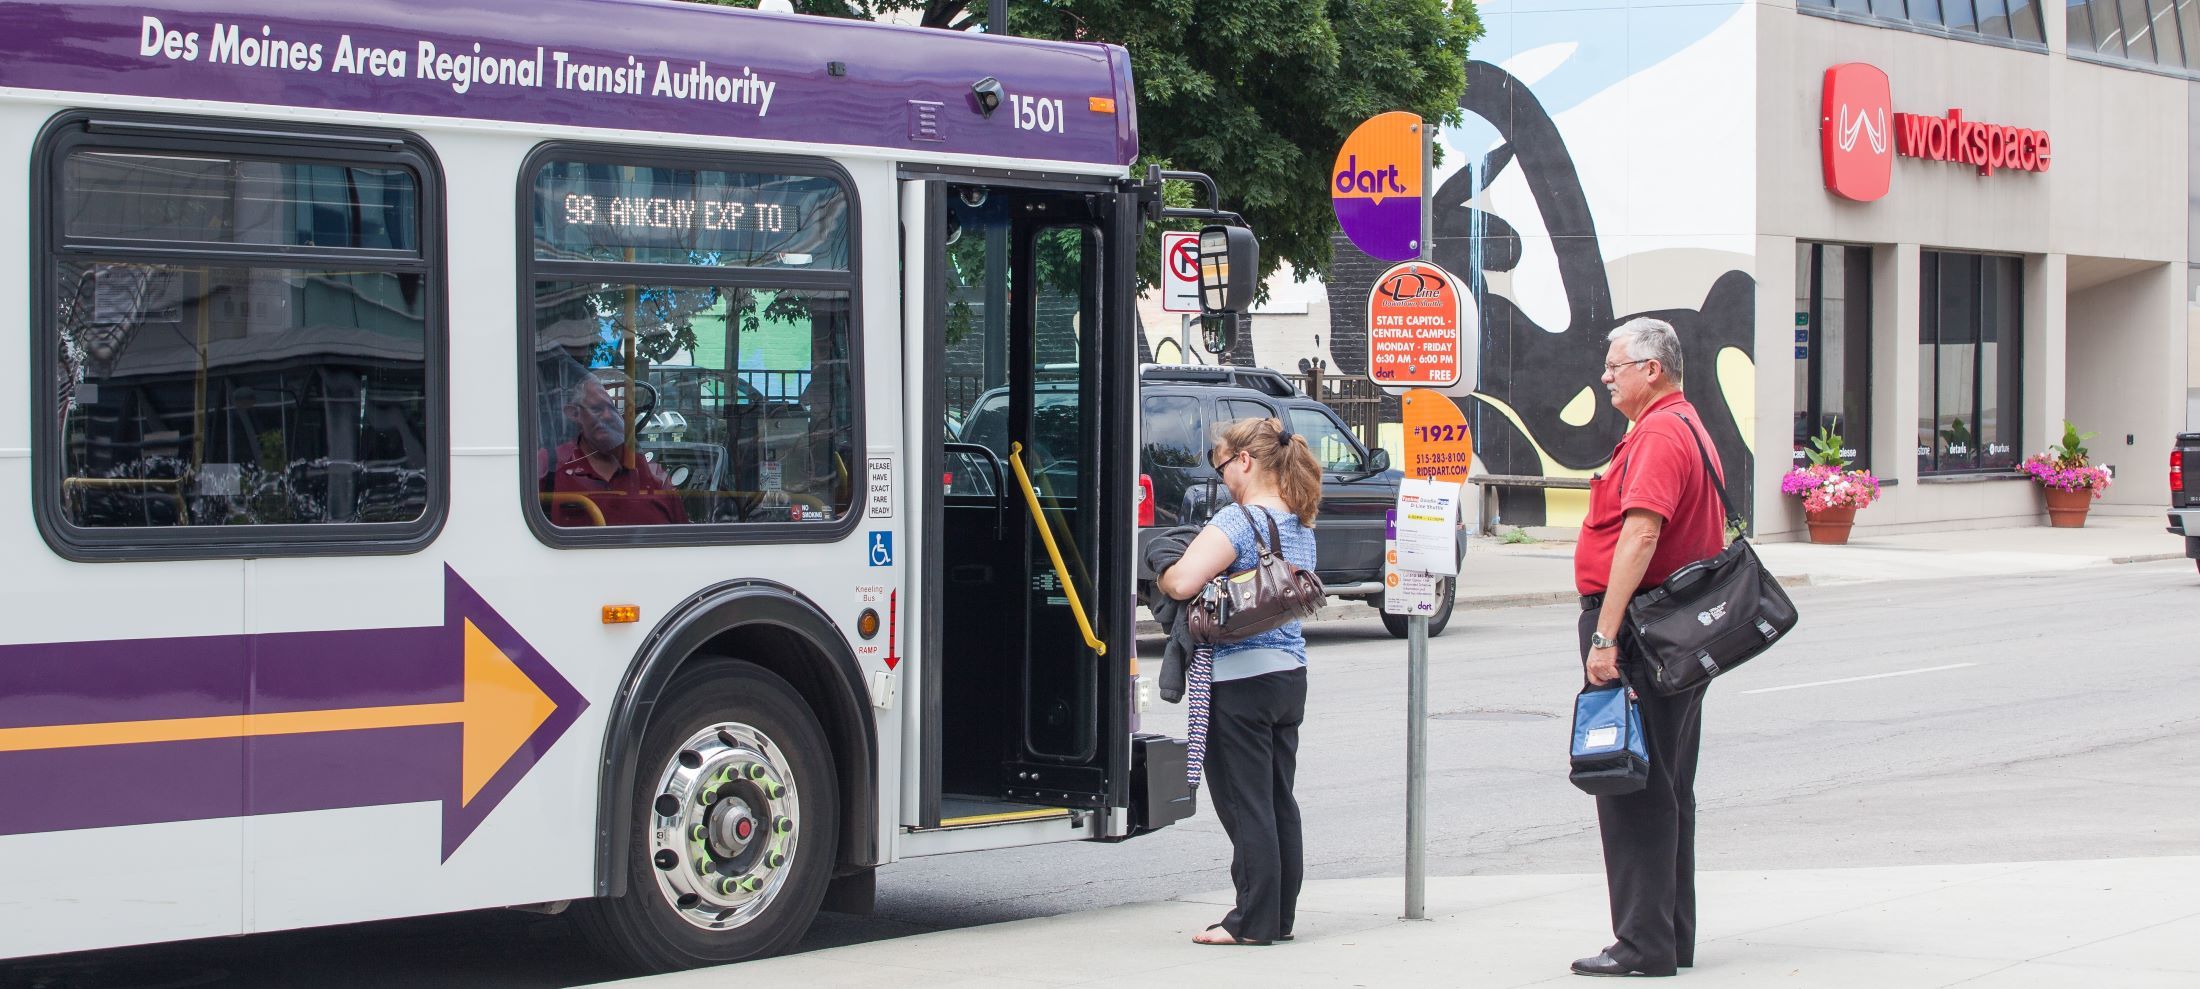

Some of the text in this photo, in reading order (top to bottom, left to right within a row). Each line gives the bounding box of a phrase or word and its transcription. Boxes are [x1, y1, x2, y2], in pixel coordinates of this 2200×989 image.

[140, 15, 776, 117] Des Moines Area Regional Transit Authority
[1010, 94, 1064, 134] 1501
[1893, 108, 2051, 177] workspace
[1336, 154, 1400, 194] dart
[565, 194, 782, 232] 98 ANKENY EXP TO
[1376, 315, 1404, 326] STATE
[1406, 315, 1446, 326] CAPITOL
[1372, 328, 1456, 339] CENTRAL CAMPUS
[1376, 342, 1415, 351] MONDAY
[1423, 342, 1453, 352] FRIDAY
[1375, 353, 1395, 363] 6:30
[1397, 354, 1412, 363] AM
[1418, 354, 1438, 364] 6:00
[1440, 354, 1453, 364] PM
[1375, 366, 1395, 378] dart
[1429, 369, 1452, 380] FREE
[1414, 424, 1468, 443] #1927
[1949, 441, 1967, 455] details
[1416, 452, 1466, 464] 515-283-8100
[869, 462, 891, 470] PLEASE
[1416, 465, 1468, 477] RIDEDART.COM
[872, 473, 888, 481] HAVE
[801, 511, 823, 519] SMOKING
[855, 585, 883, 594] Kneeling
[863, 594, 876, 602] Bus
[1417, 600, 1432, 610] dart
[858, 646, 878, 654] RAMP
